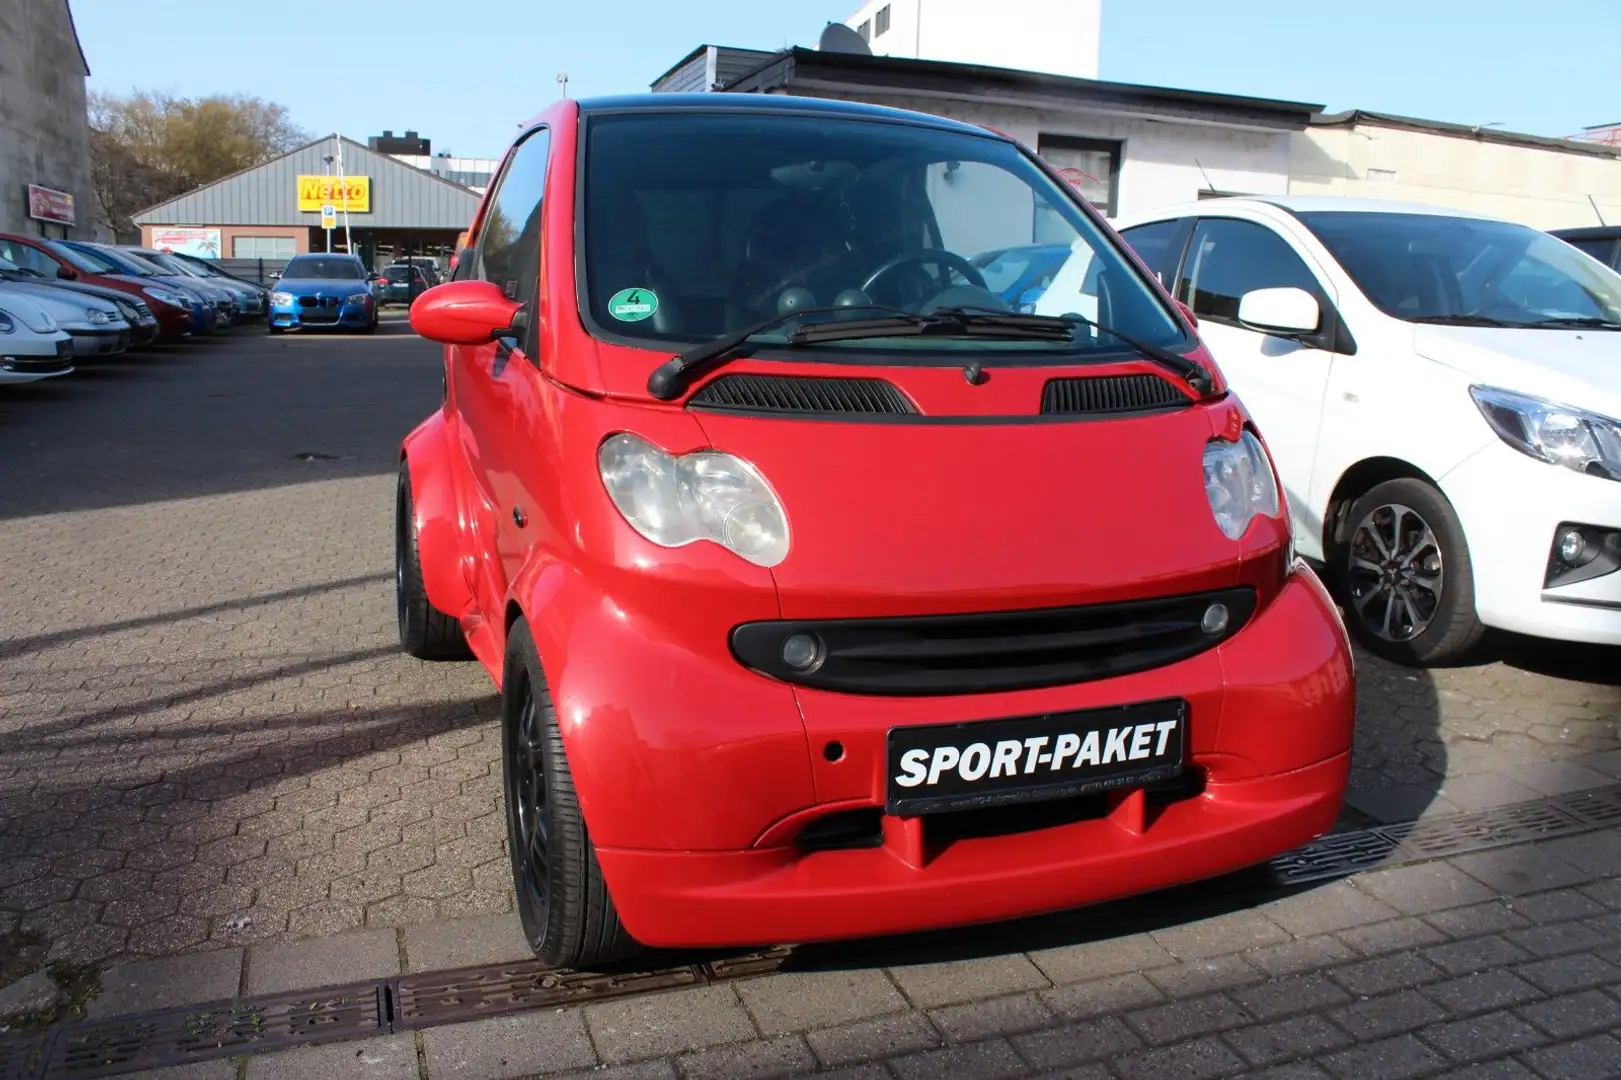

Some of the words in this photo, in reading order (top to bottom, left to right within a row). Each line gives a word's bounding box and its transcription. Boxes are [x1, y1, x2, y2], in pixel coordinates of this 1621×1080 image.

[301, 178, 366, 200] Netto
[626, 290, 641, 304] 4
[895, 720, 1178, 788] SPORT-PAKET
